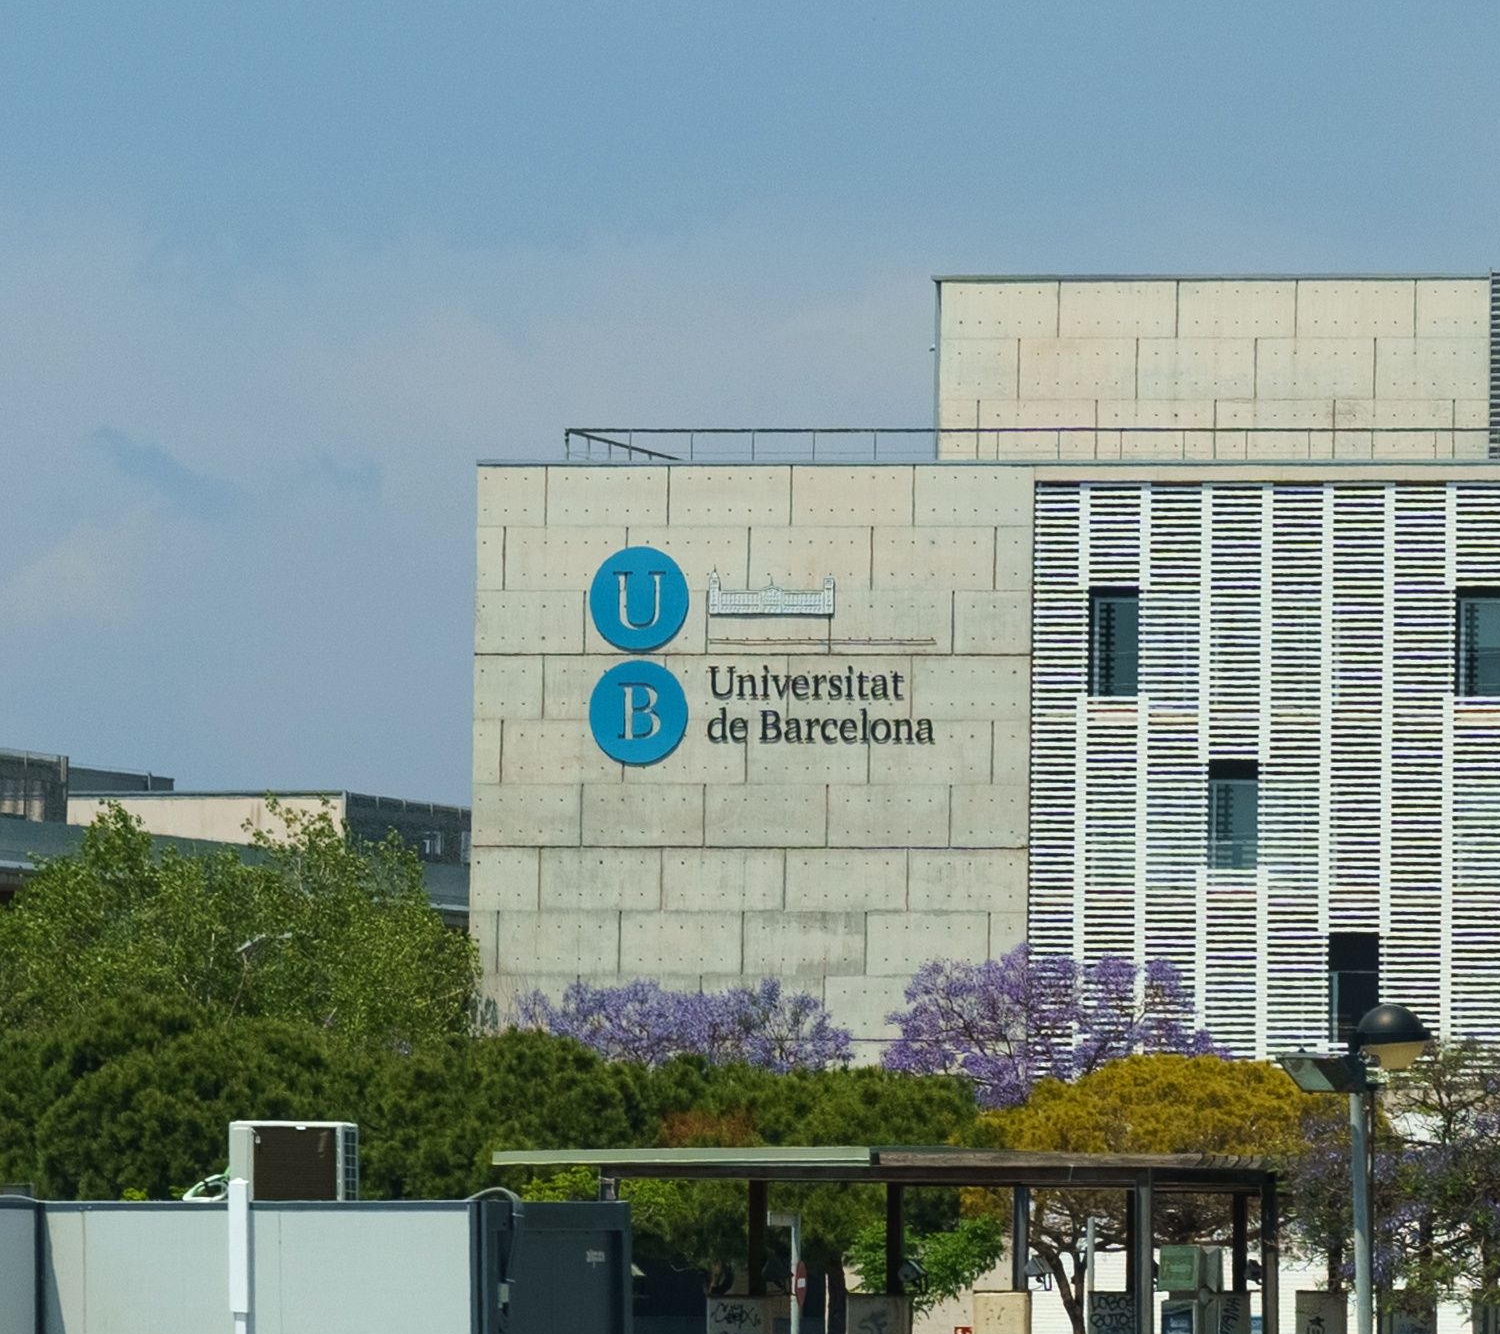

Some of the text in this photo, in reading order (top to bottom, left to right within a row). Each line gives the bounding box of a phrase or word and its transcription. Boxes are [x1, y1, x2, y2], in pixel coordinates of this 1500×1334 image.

[613, 571, 666, 630] U
[708, 665, 904, 700] Universitat
[617, 683, 662, 740] B
[707, 707, 935, 744] de Barcelona
